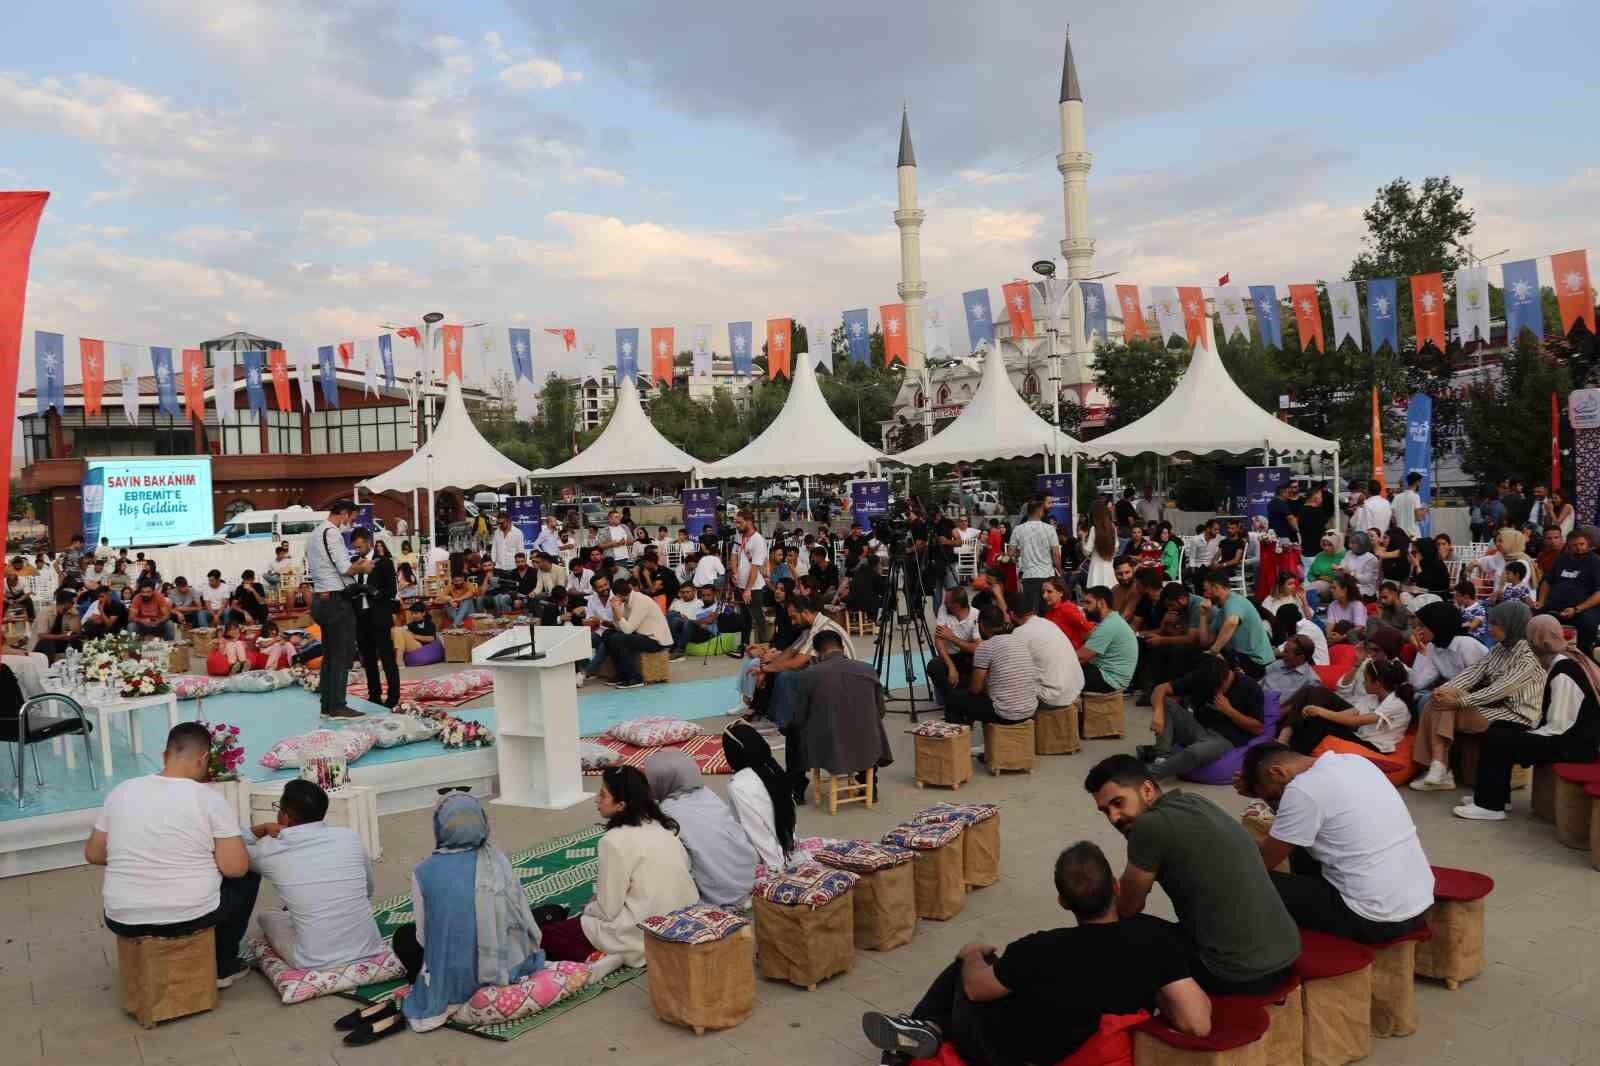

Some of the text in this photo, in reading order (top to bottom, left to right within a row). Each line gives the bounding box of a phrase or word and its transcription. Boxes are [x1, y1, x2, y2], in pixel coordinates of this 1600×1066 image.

[107, 474, 196, 488] SAYIN BAKANIM
[118, 500, 188, 519] Hoş Geldiniz
